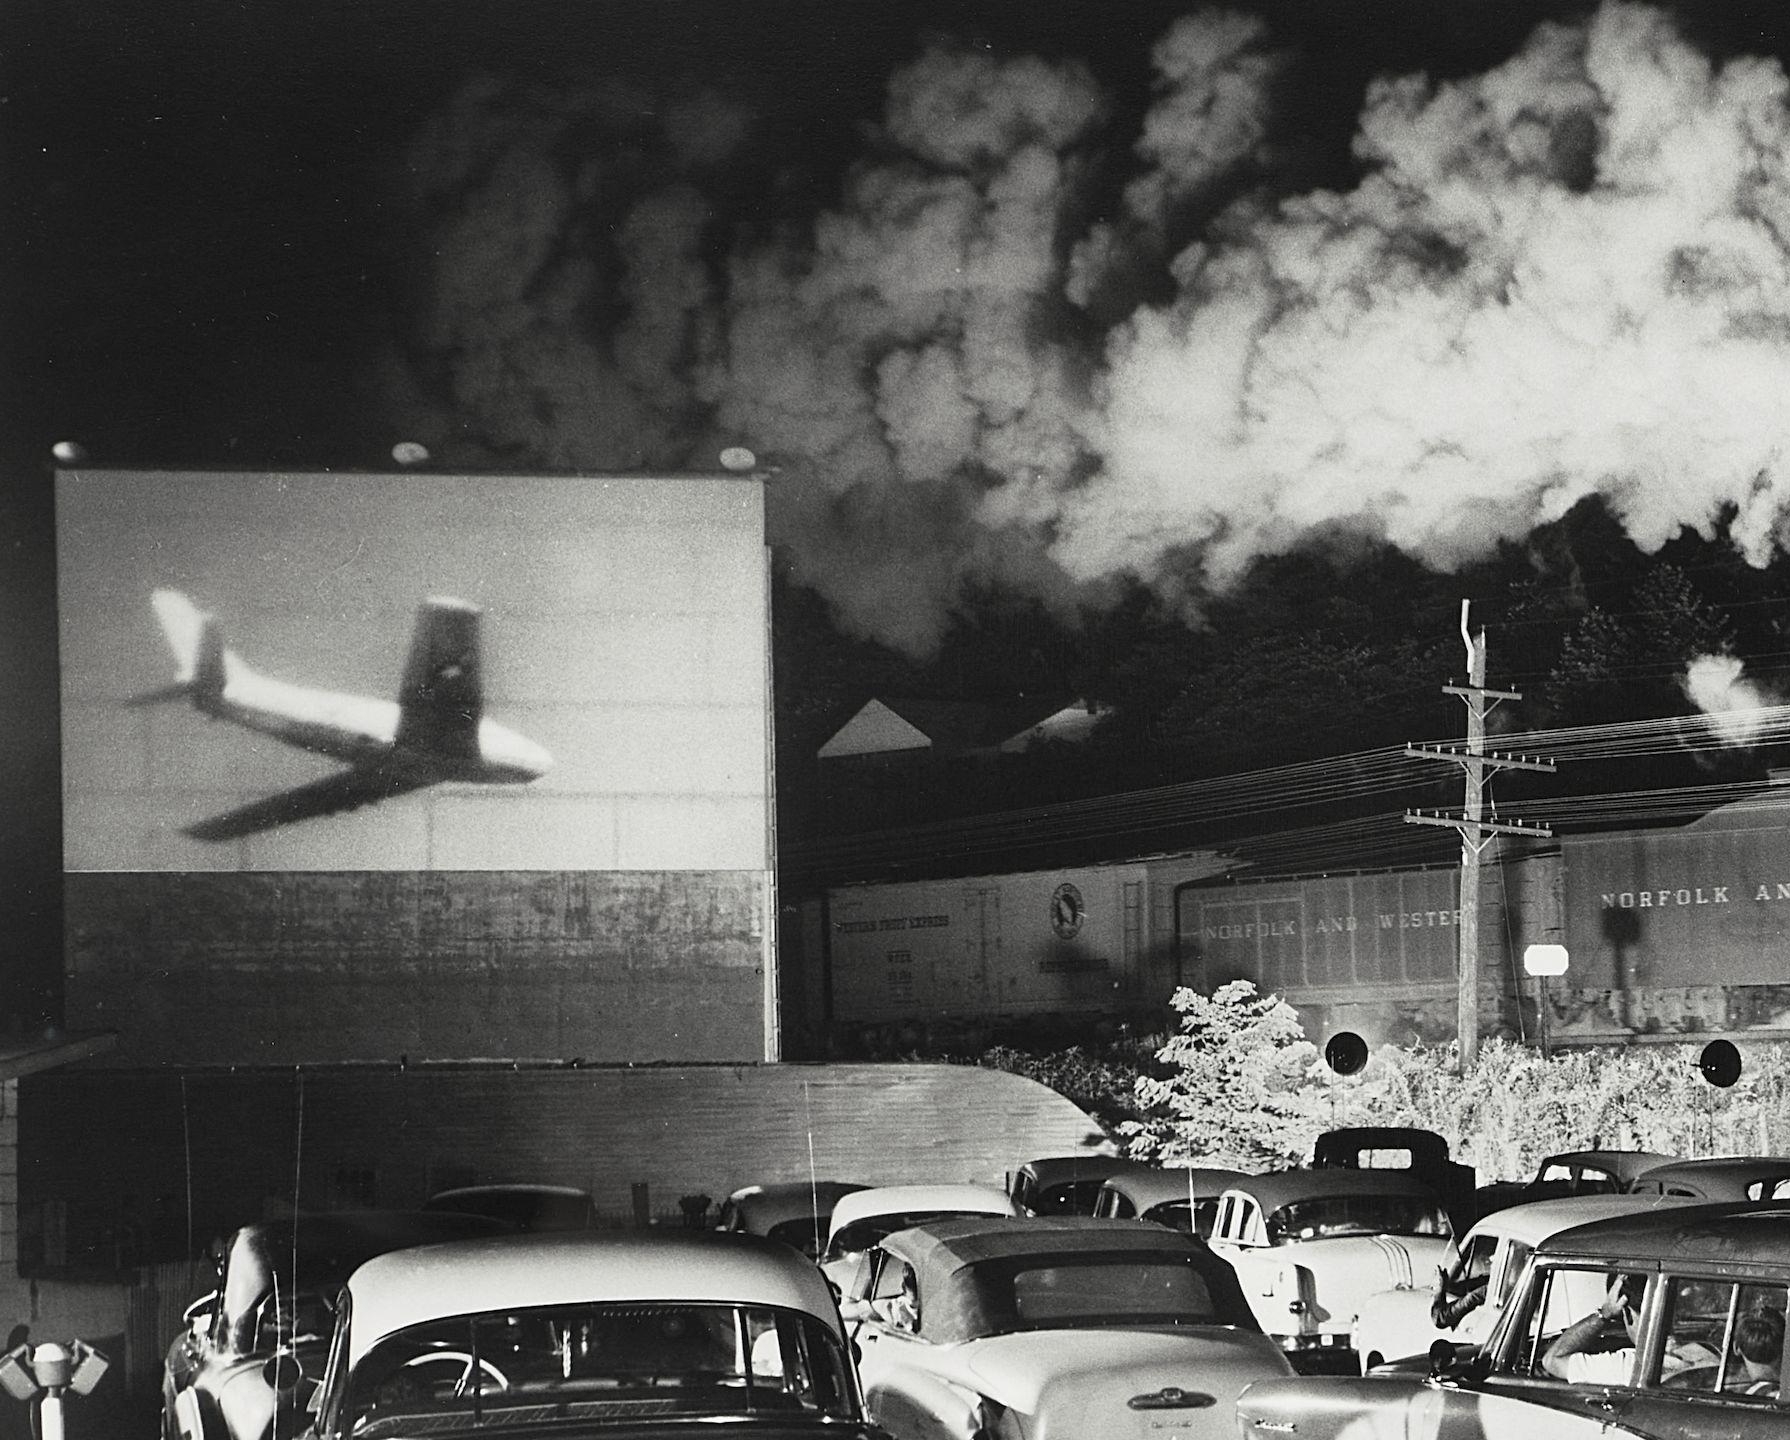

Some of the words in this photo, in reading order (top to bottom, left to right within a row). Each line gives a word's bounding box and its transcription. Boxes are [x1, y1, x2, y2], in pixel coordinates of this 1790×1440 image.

[1601, 886, 1729, 909] NORFOLK
[1206, 920, 1297, 939] NORFOLK
[1315, 916, 1358, 934] AND
